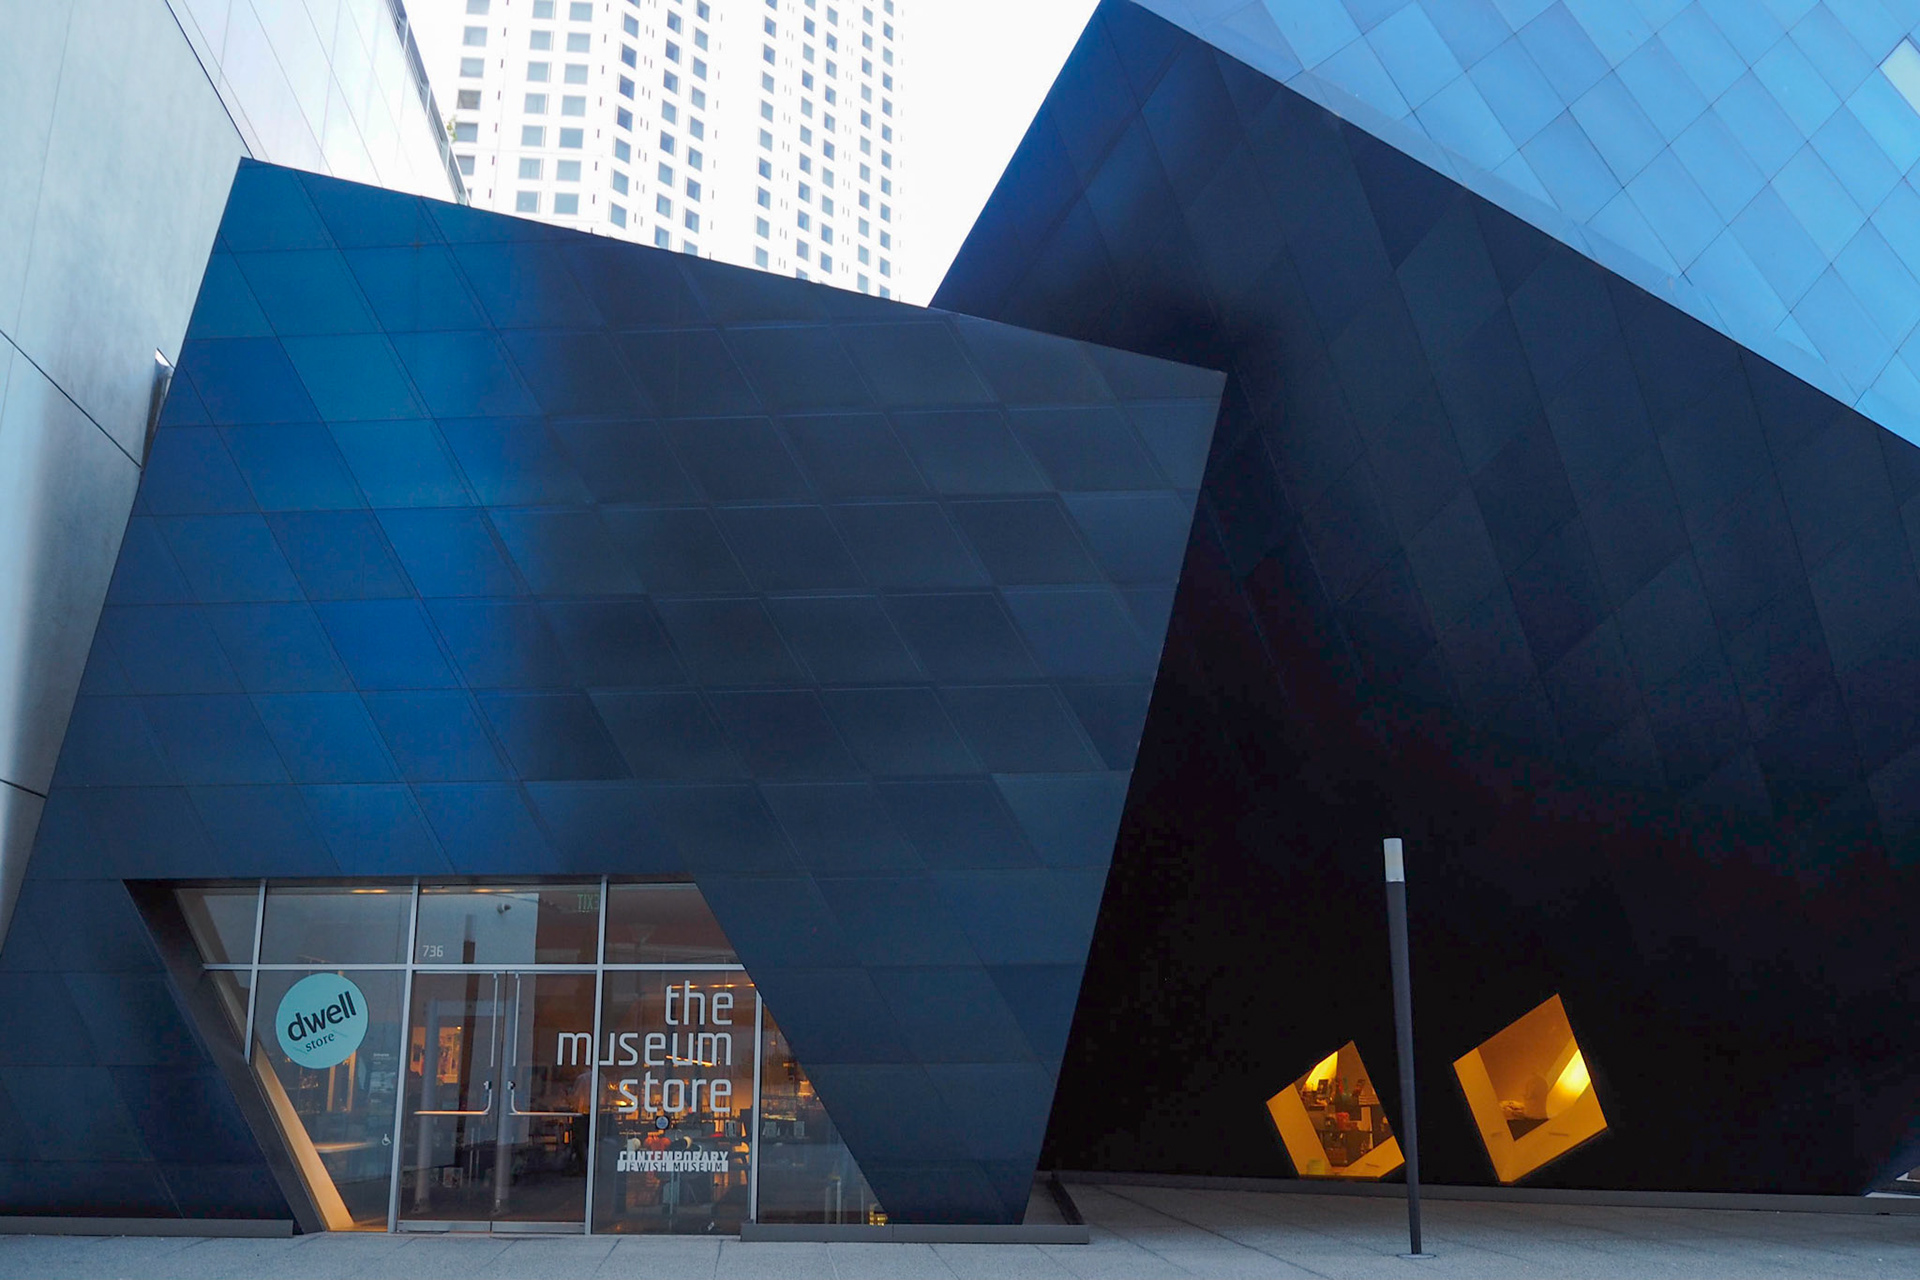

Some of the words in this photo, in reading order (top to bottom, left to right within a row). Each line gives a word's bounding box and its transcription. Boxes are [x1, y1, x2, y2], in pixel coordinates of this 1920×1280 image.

[422, 944, 444, 958] 736
[287, 991, 357, 1042] dwell
[665, 980, 734, 1026] the
[305, 1032, 335, 1053] store
[556, 1032, 733, 1066] museum
[618, 1071, 732, 1113] store
[619, 1151, 729, 1161] CONTEMPORARY
[623, 1161, 668, 1172] JEWISH
[673, 1161, 723, 1172] MUSEUM
